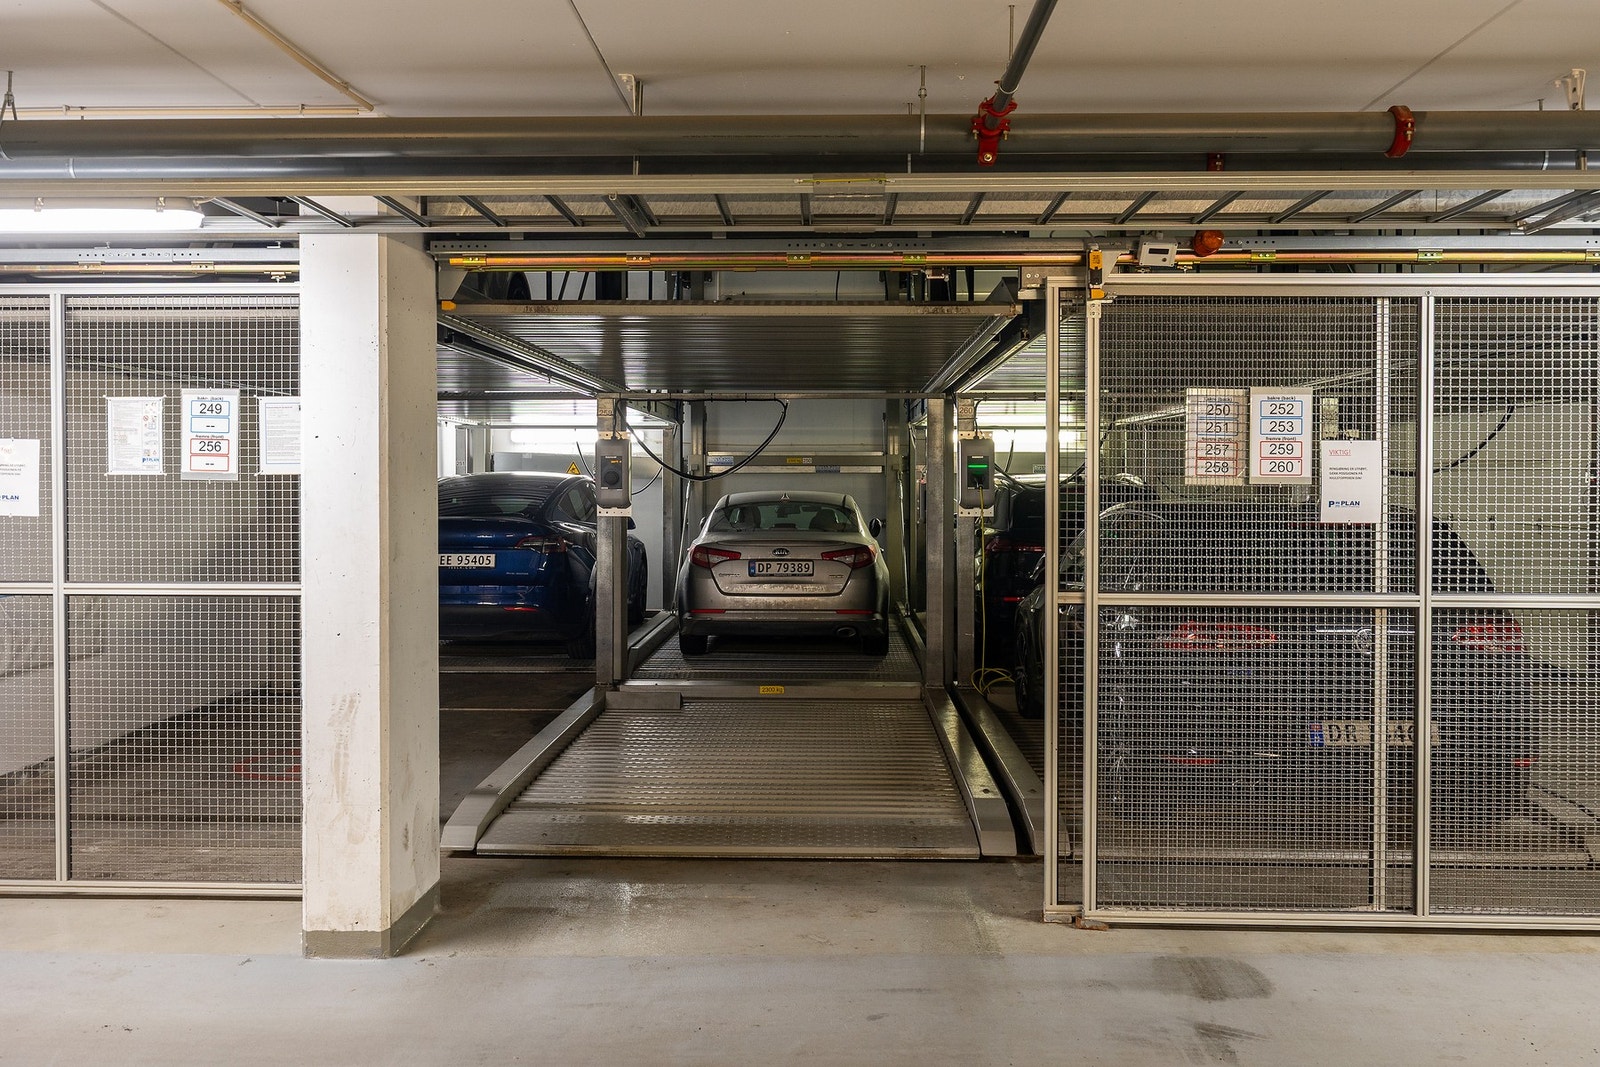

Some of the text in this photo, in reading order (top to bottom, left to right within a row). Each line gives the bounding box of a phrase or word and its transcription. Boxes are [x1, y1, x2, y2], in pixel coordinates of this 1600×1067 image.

[199, 403, 222, 414] 249
[1206, 404, 1231, 416] 250
[1269, 403, 1294, 415] 252
[1206, 422, 1229, 433] 251
[1269, 421, 1294, 432] 253
[198, 440, 222, 452] 256
[1205, 444, 1230, 455] 257
[1269, 443, 1294, 455] 259
[1204, 461, 1229, 473] 258
[1269, 461, 1294, 472] 260
[440, 555, 491, 565] EE 95405
[757, 562, 810, 573] DP 79389
